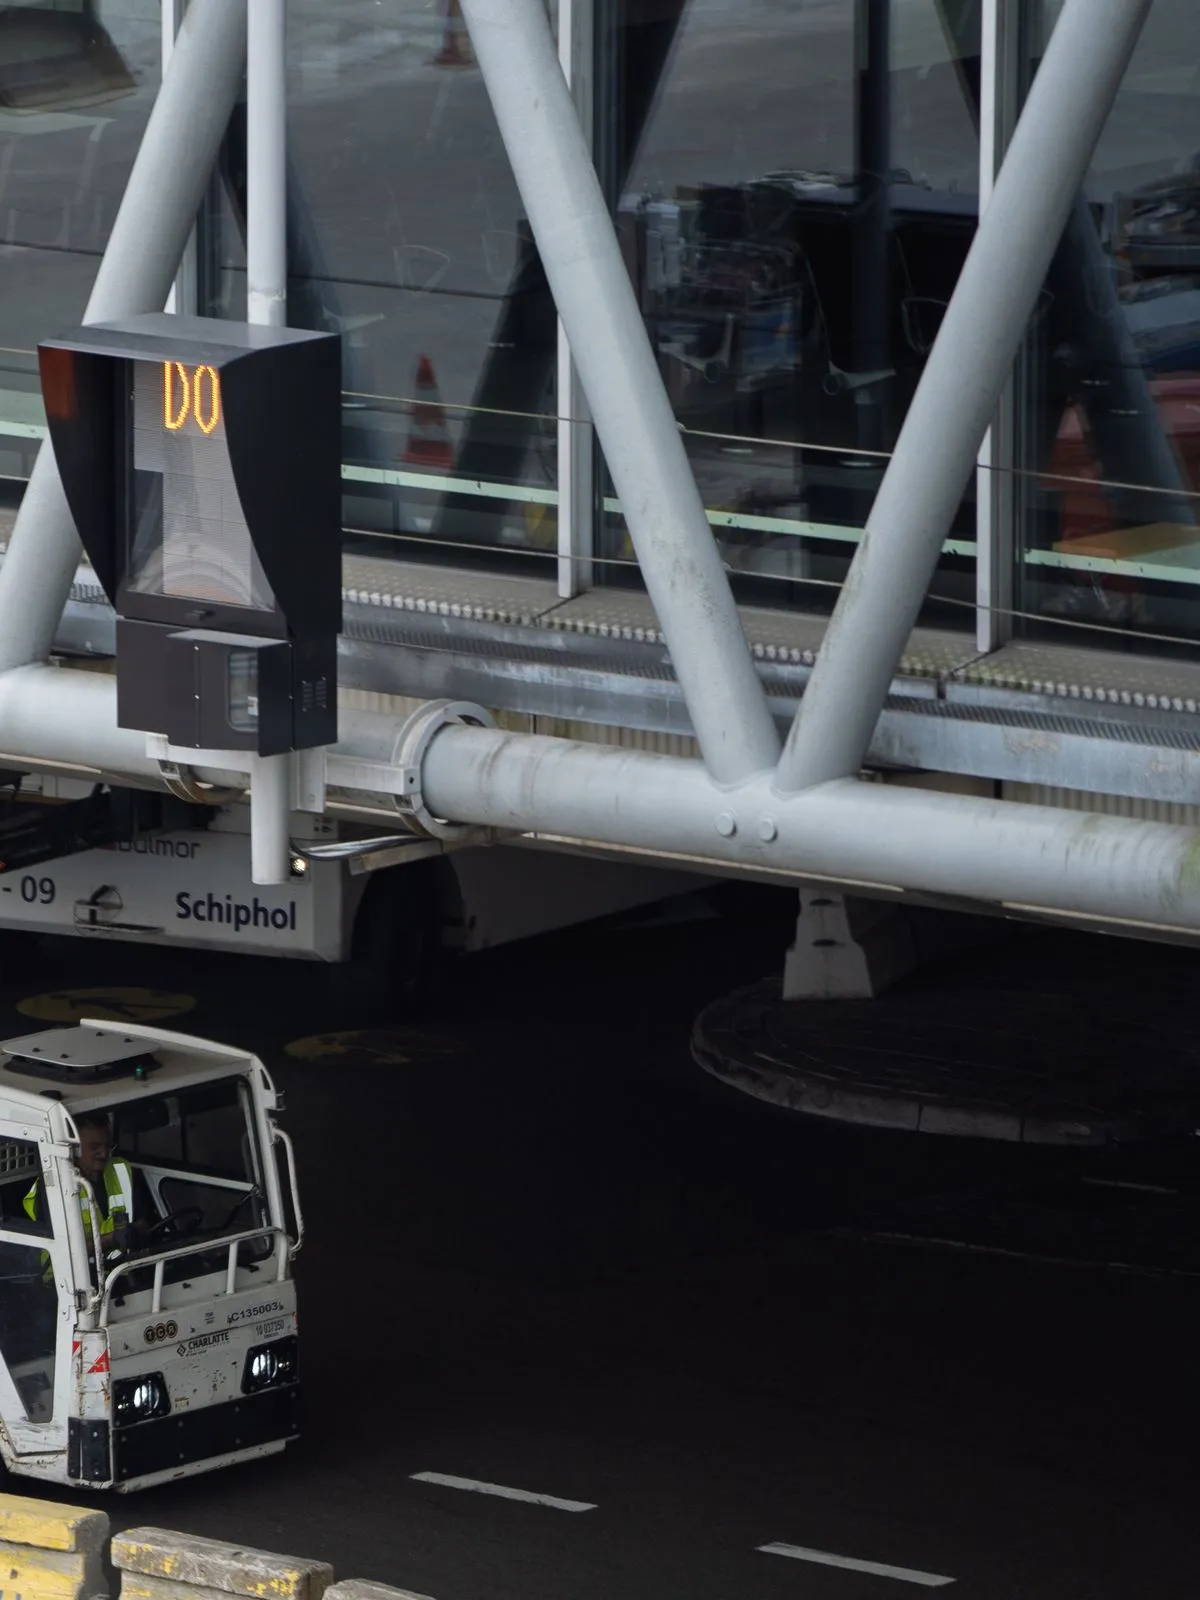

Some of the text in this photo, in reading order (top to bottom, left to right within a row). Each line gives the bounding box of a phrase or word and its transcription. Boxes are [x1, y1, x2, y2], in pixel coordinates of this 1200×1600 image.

[21, 875, 56, 905] 09
[176, 891, 296, 932] Schiphol
[144, 1319, 178, 1345] TCR
[188, 1331, 230, 1350] CHARLATTE
